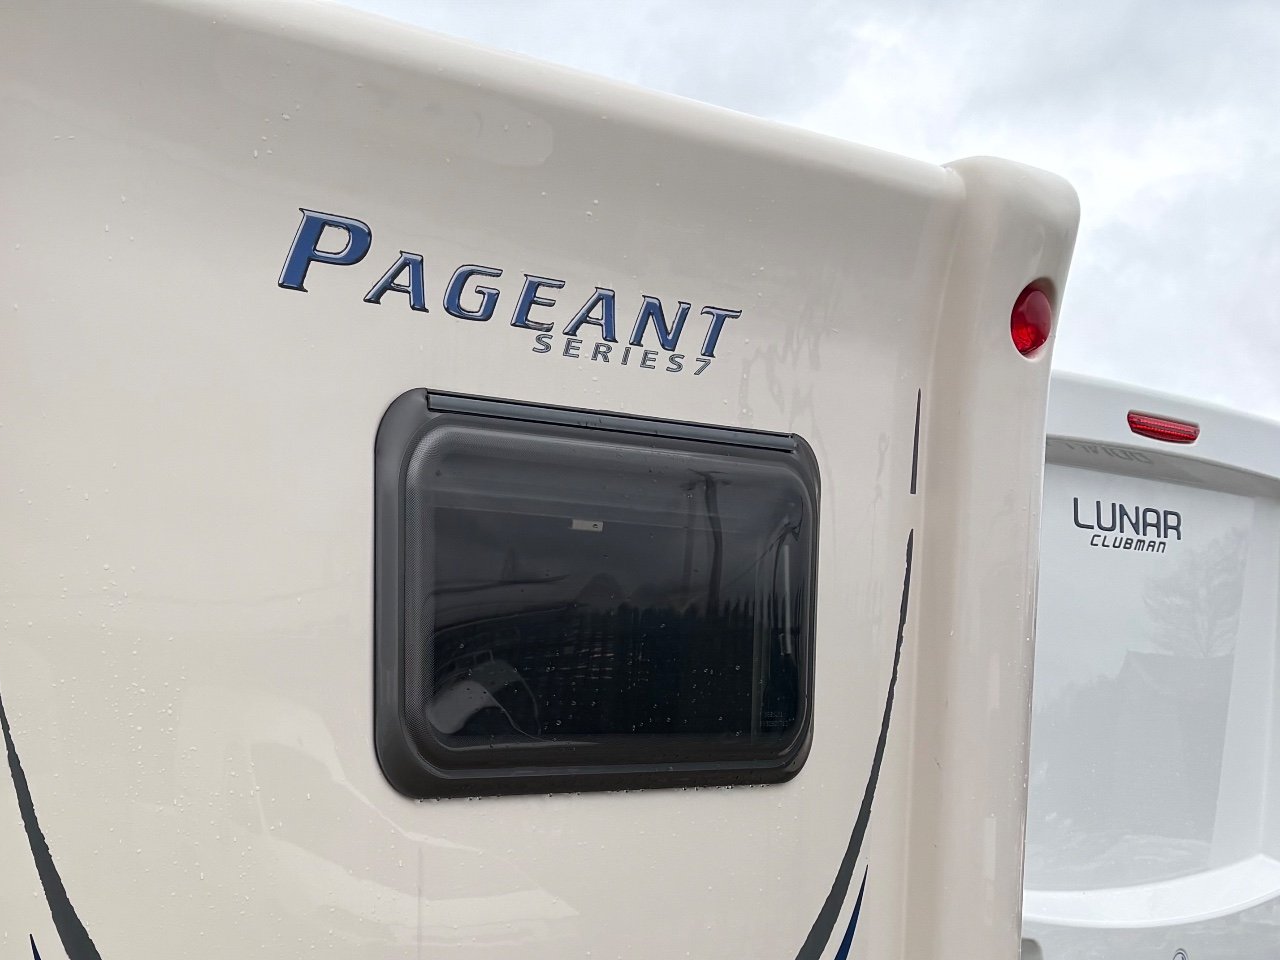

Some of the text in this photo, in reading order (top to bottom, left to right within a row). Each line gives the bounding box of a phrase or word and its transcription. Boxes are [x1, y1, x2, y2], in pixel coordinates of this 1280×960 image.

[277, 207, 743, 358] PAGEANT
[1073, 496, 1182, 540] LUNAR
[1090, 534, 1167, 553] CLUBMAN
